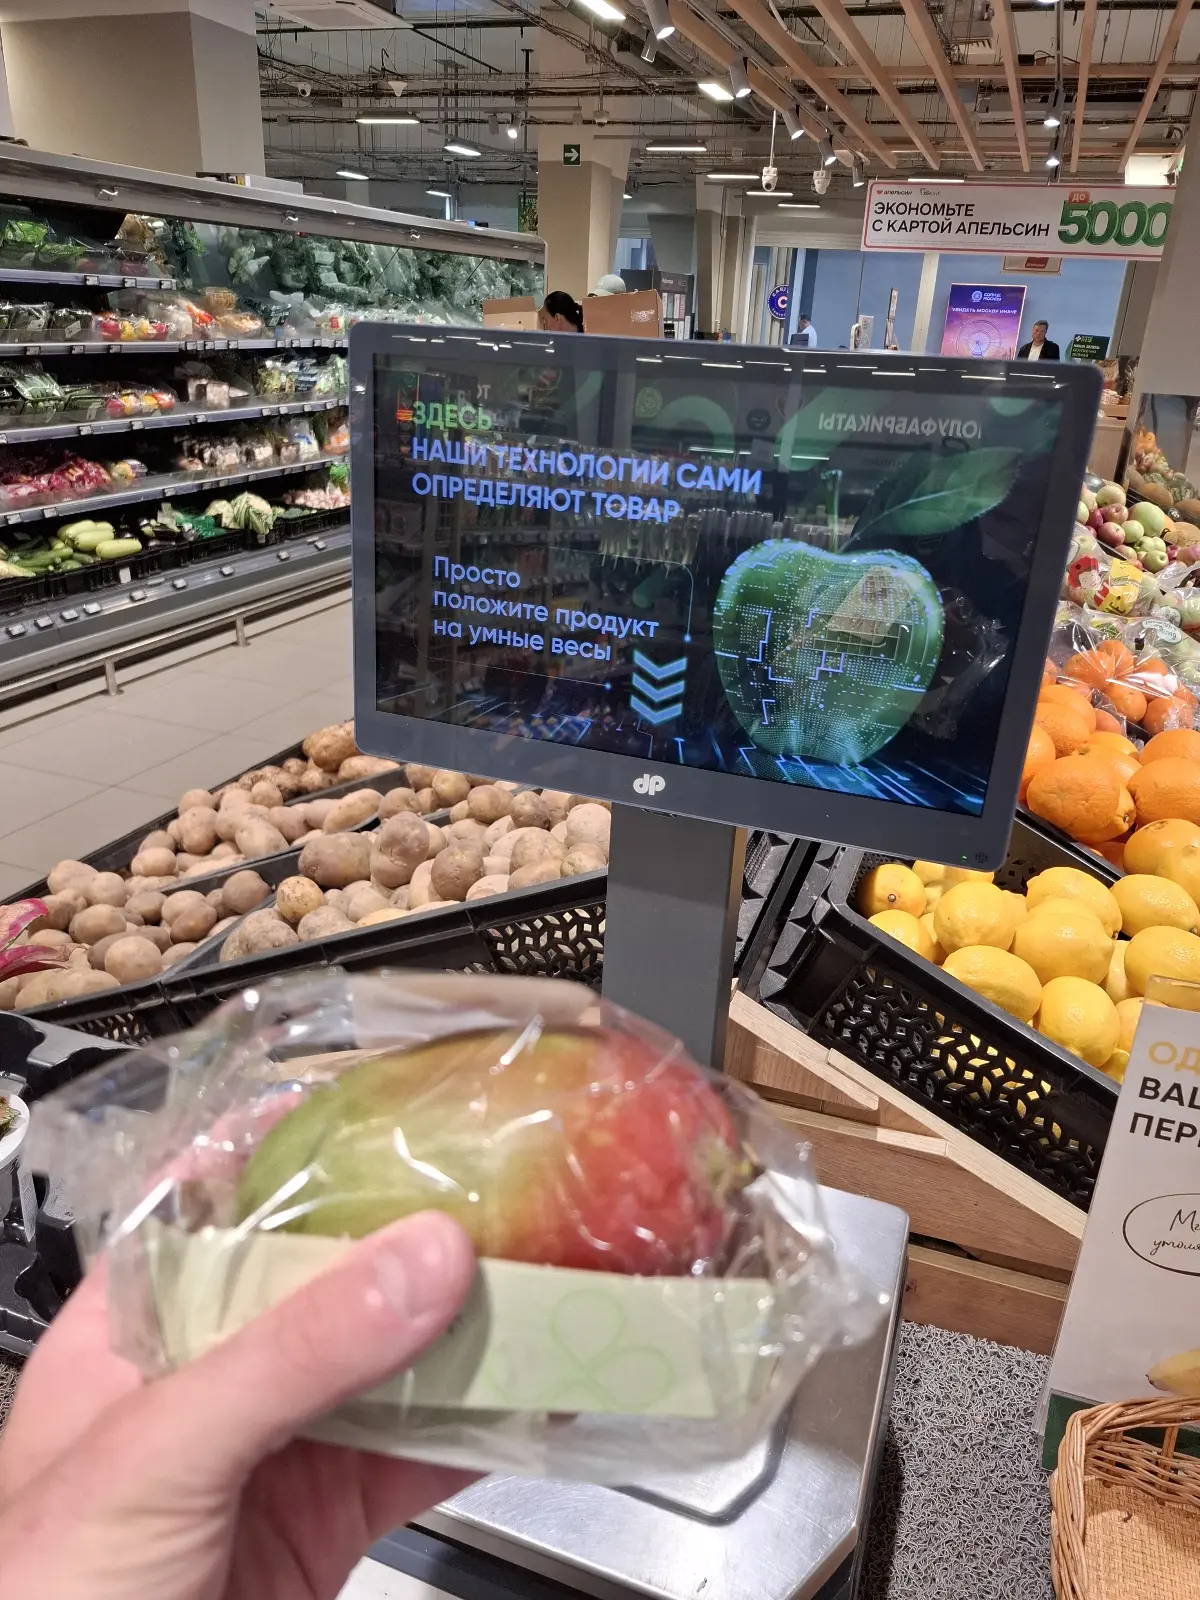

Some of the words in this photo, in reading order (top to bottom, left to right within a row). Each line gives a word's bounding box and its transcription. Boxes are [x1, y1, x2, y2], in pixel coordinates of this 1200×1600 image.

[873, 201, 976, 217] ЭКОНОМЬТЕ
[1071, 193, 1086, 203] ДО
[871, 219, 884, 232] С
[886, 217, 953, 234] КАРТОЙ
[955, 221, 1050, 237] АПЕЛЬСИН
[1057, 200, 1173, 248] 5000
[412, 401, 493, 432] ЗДЕСЬ
[412, 436, 487, 467] НАШИ
[495, 445, 669, 487] ТЕХНОЛОГИИ
[676, 463, 763, 495] САМИ
[411, 472, 585, 515] ОПРЕДЕЛЯЮТ
[591, 491, 681, 524] ТОВАР
[433, 555, 521, 589] Просто
[433, 590, 549, 623] положите
[555, 606, 660, 640] продукт
[433, 618, 463, 639] на
[467, 622, 545, 651] умные
[551, 637, 612, 661] весы
